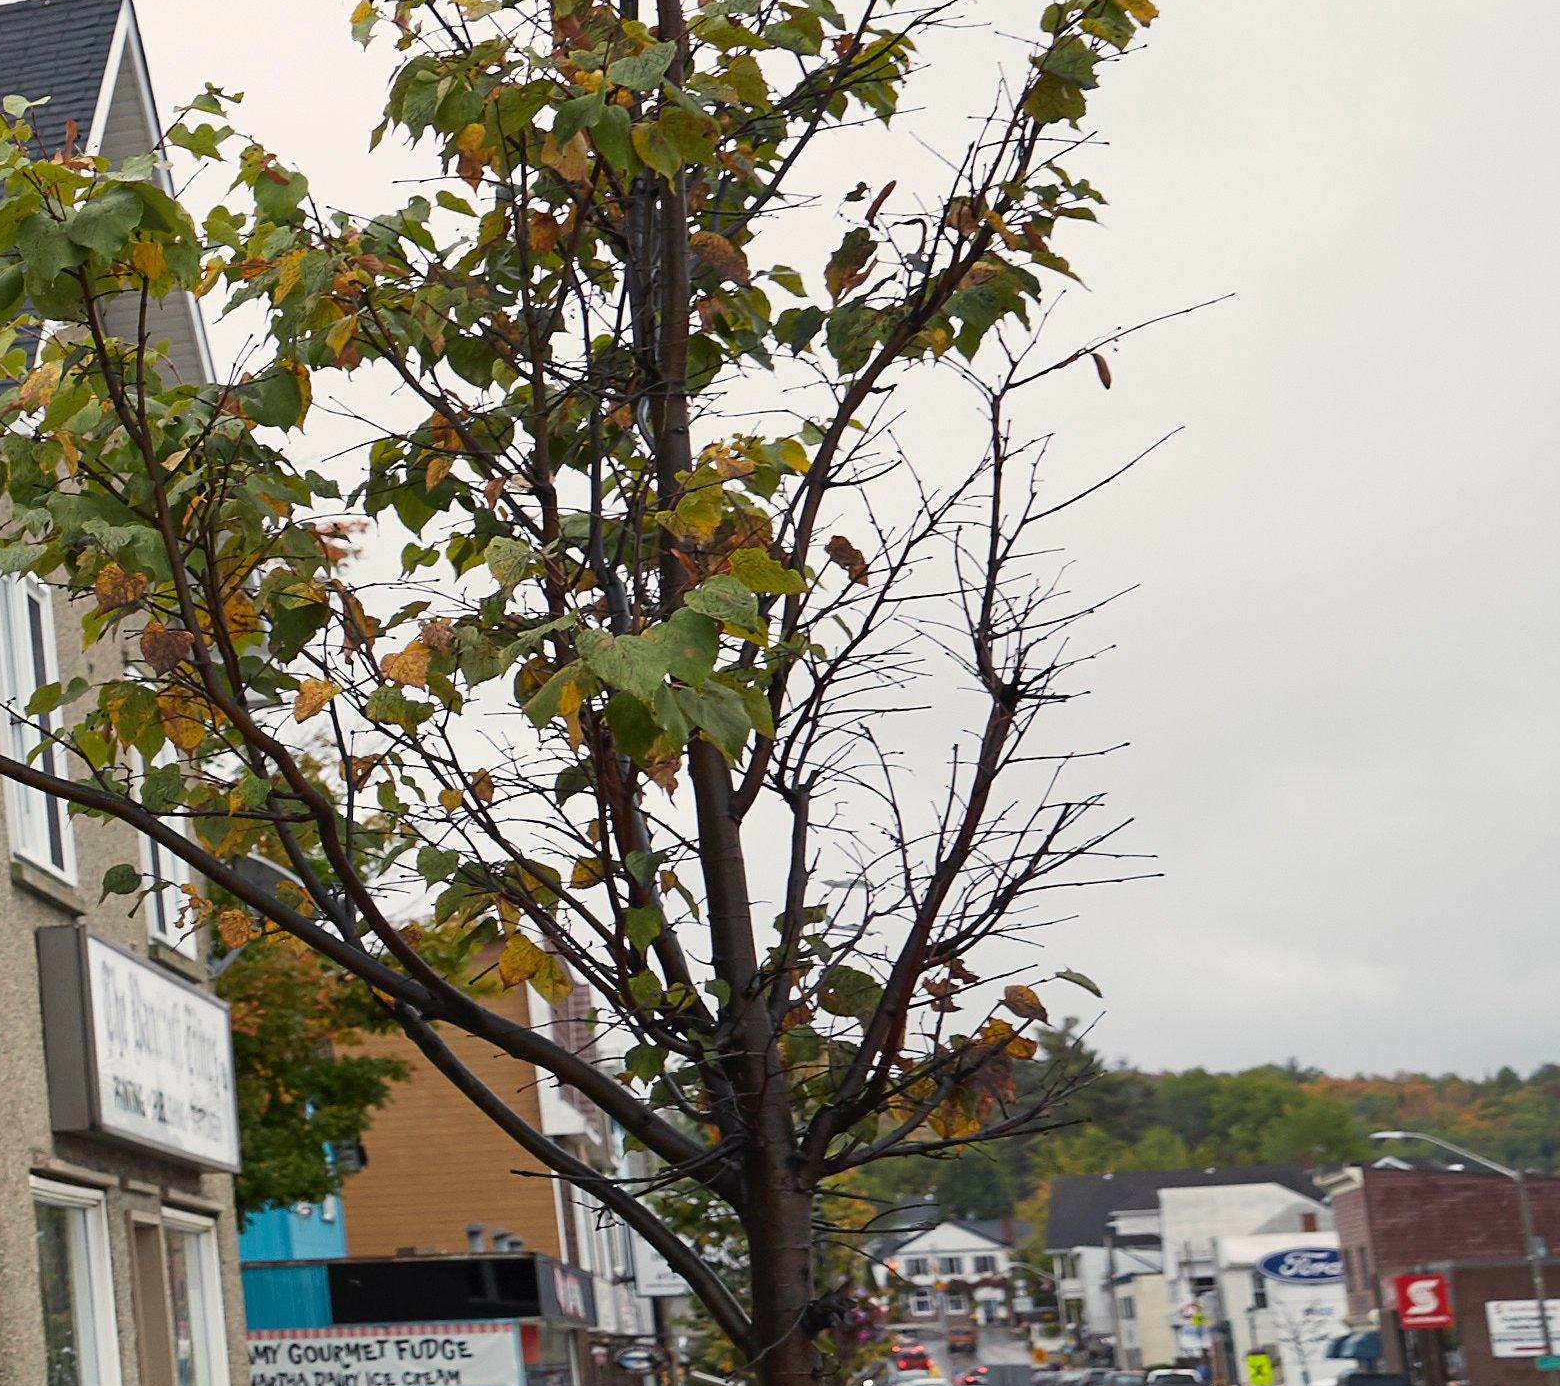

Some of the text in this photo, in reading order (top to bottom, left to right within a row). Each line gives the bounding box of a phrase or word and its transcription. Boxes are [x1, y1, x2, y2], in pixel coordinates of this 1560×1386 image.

[287, 1339, 389, 1365] GOURMET
[394, 1338, 475, 1361] FUDGE
[365, 1370, 396, 1386] ICE
